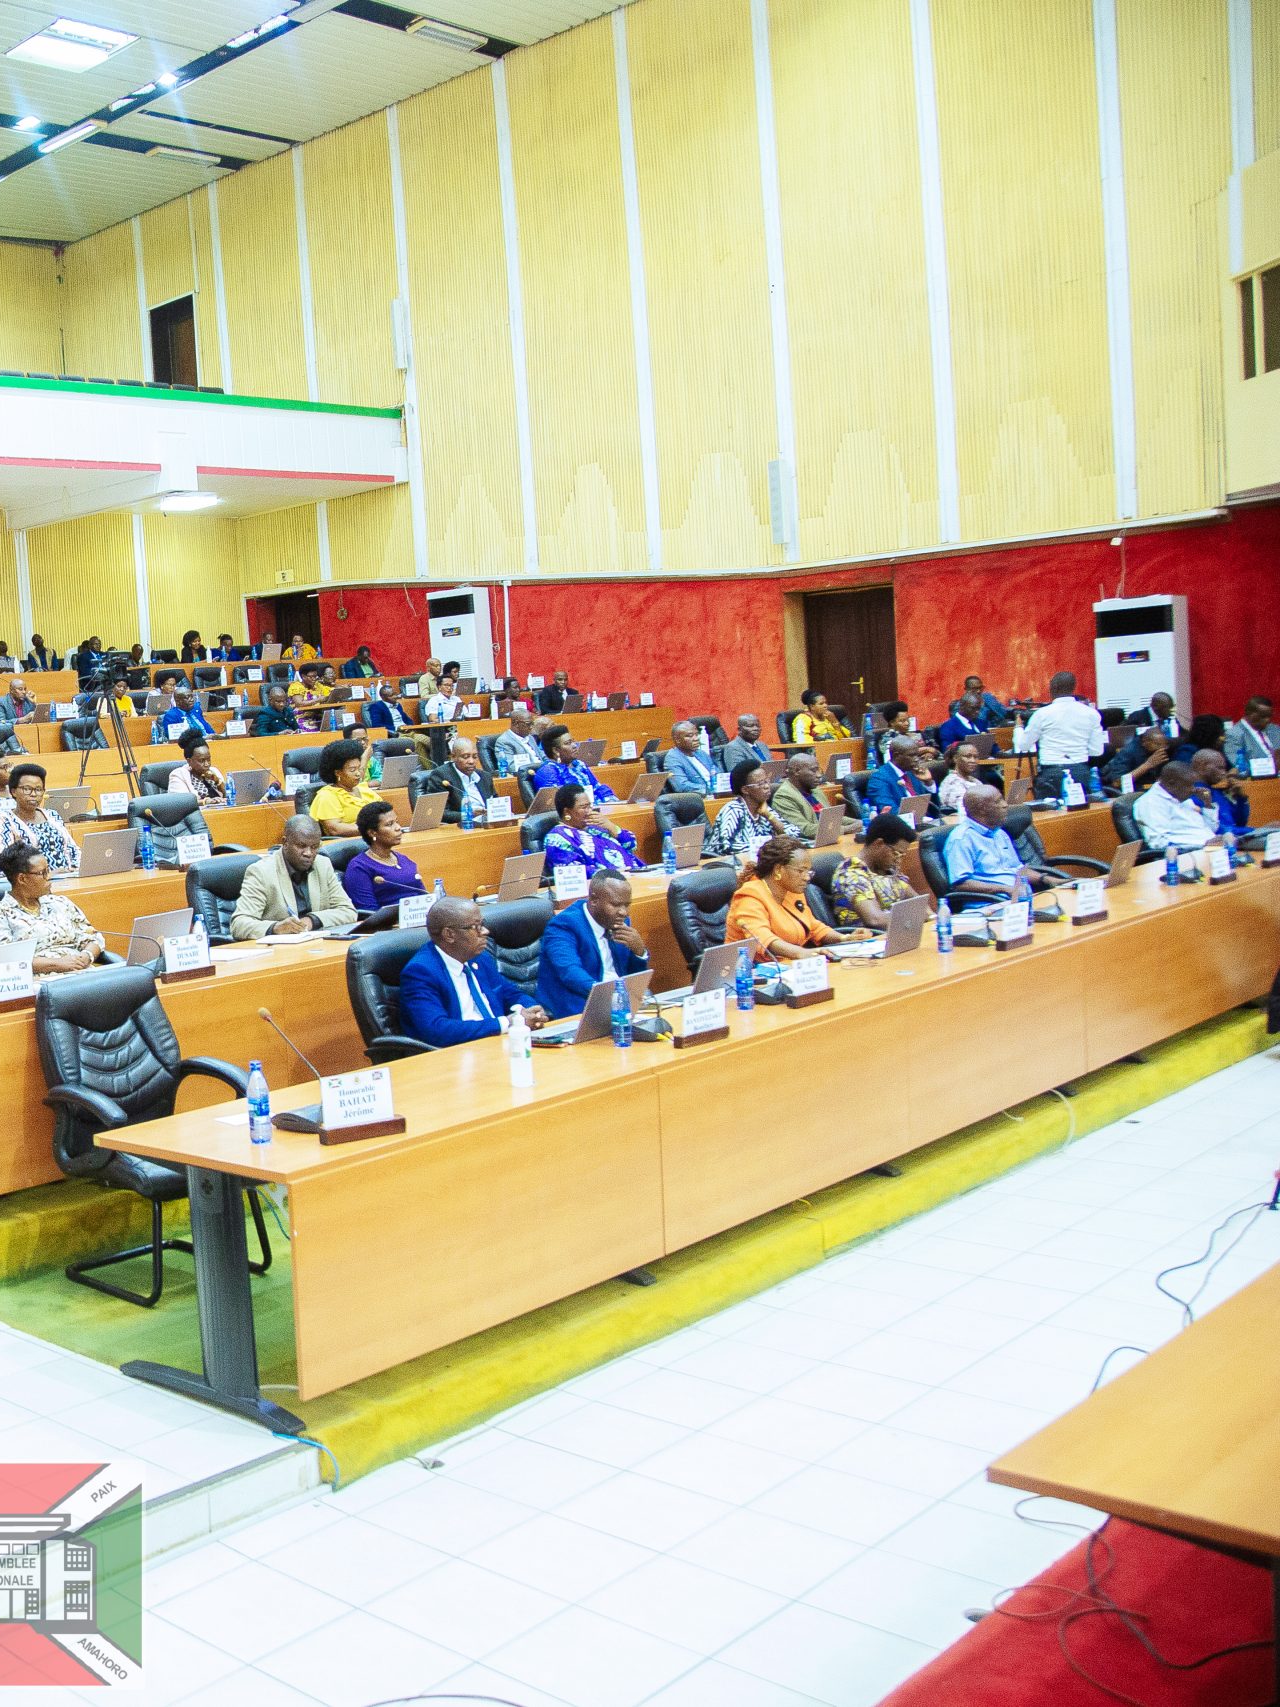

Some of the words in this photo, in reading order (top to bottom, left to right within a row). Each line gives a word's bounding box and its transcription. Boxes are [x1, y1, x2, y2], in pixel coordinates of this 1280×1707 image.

[12, 983, 29, 992] Jean
[339, 1084, 376, 1097] Honorable
[339, 1094, 376, 1108] BAHATI
